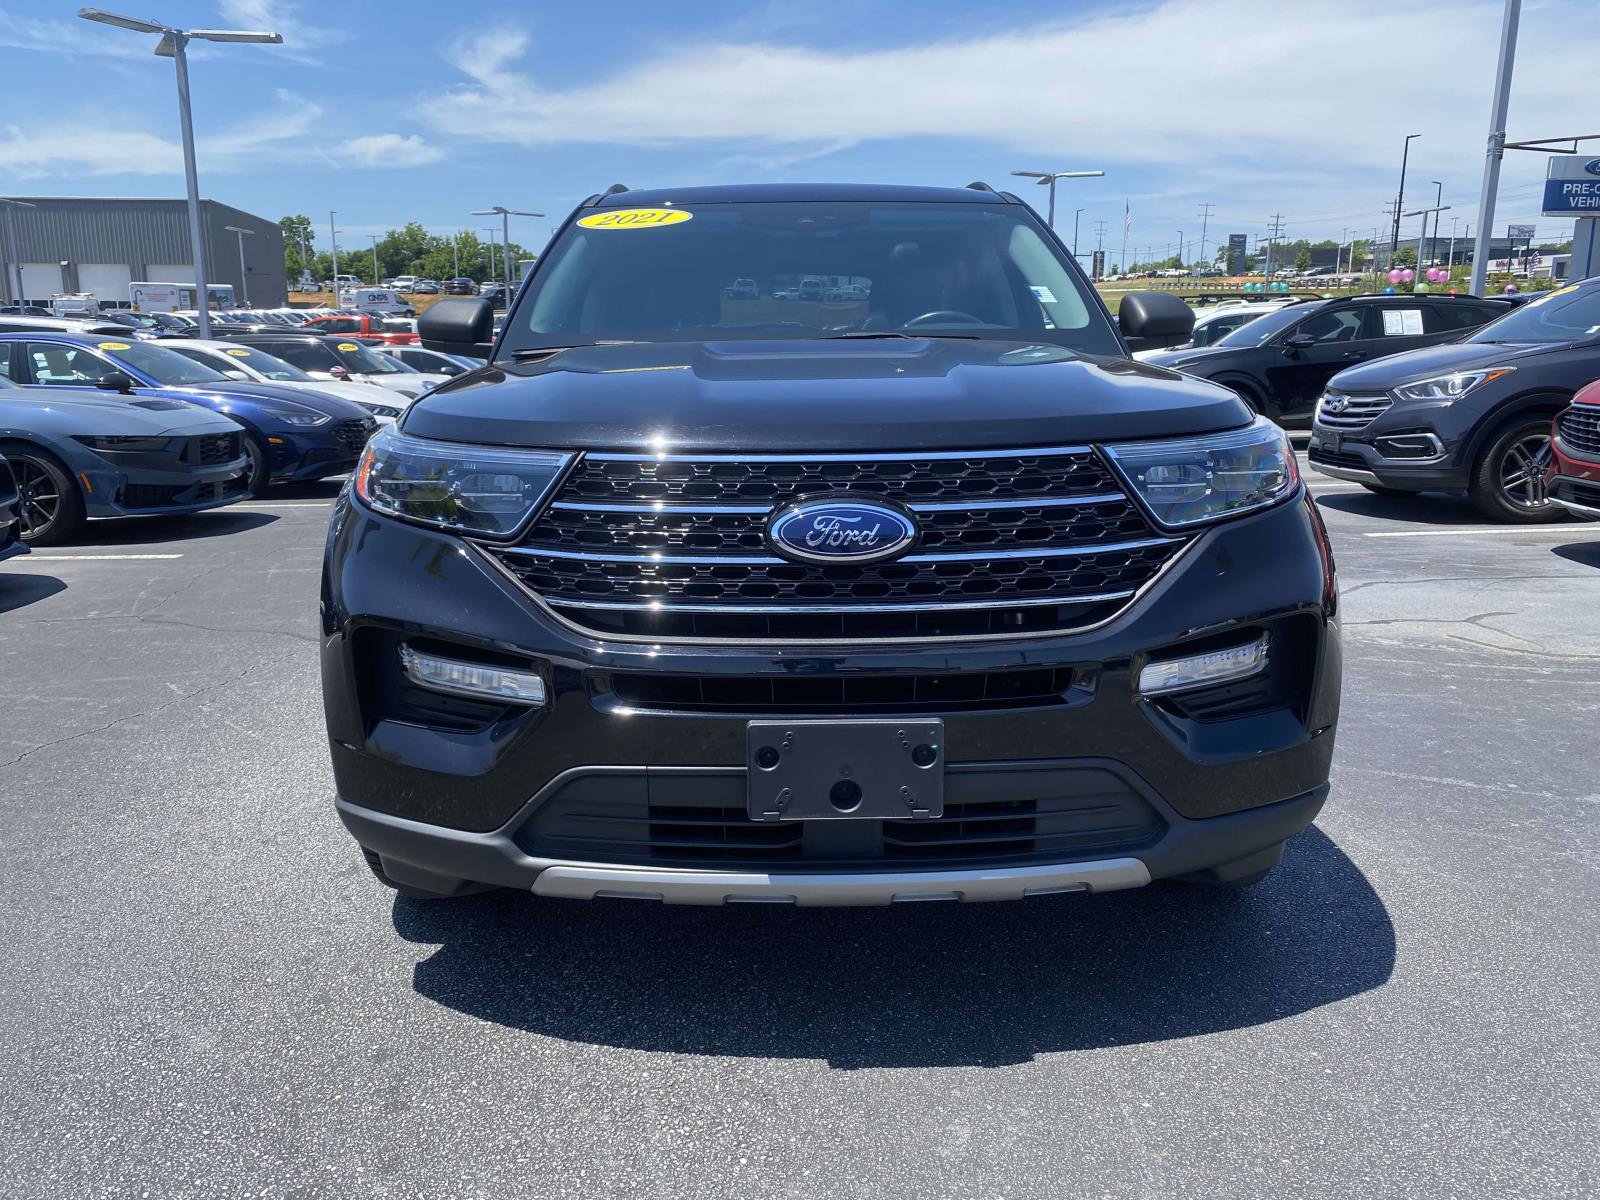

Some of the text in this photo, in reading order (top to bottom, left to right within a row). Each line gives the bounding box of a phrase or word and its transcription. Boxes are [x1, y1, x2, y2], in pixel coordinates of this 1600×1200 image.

[1569, 196, 1600, 207] VEHI
[595, 212, 674, 226] 2021
[806, 515, 881, 546] Ford
